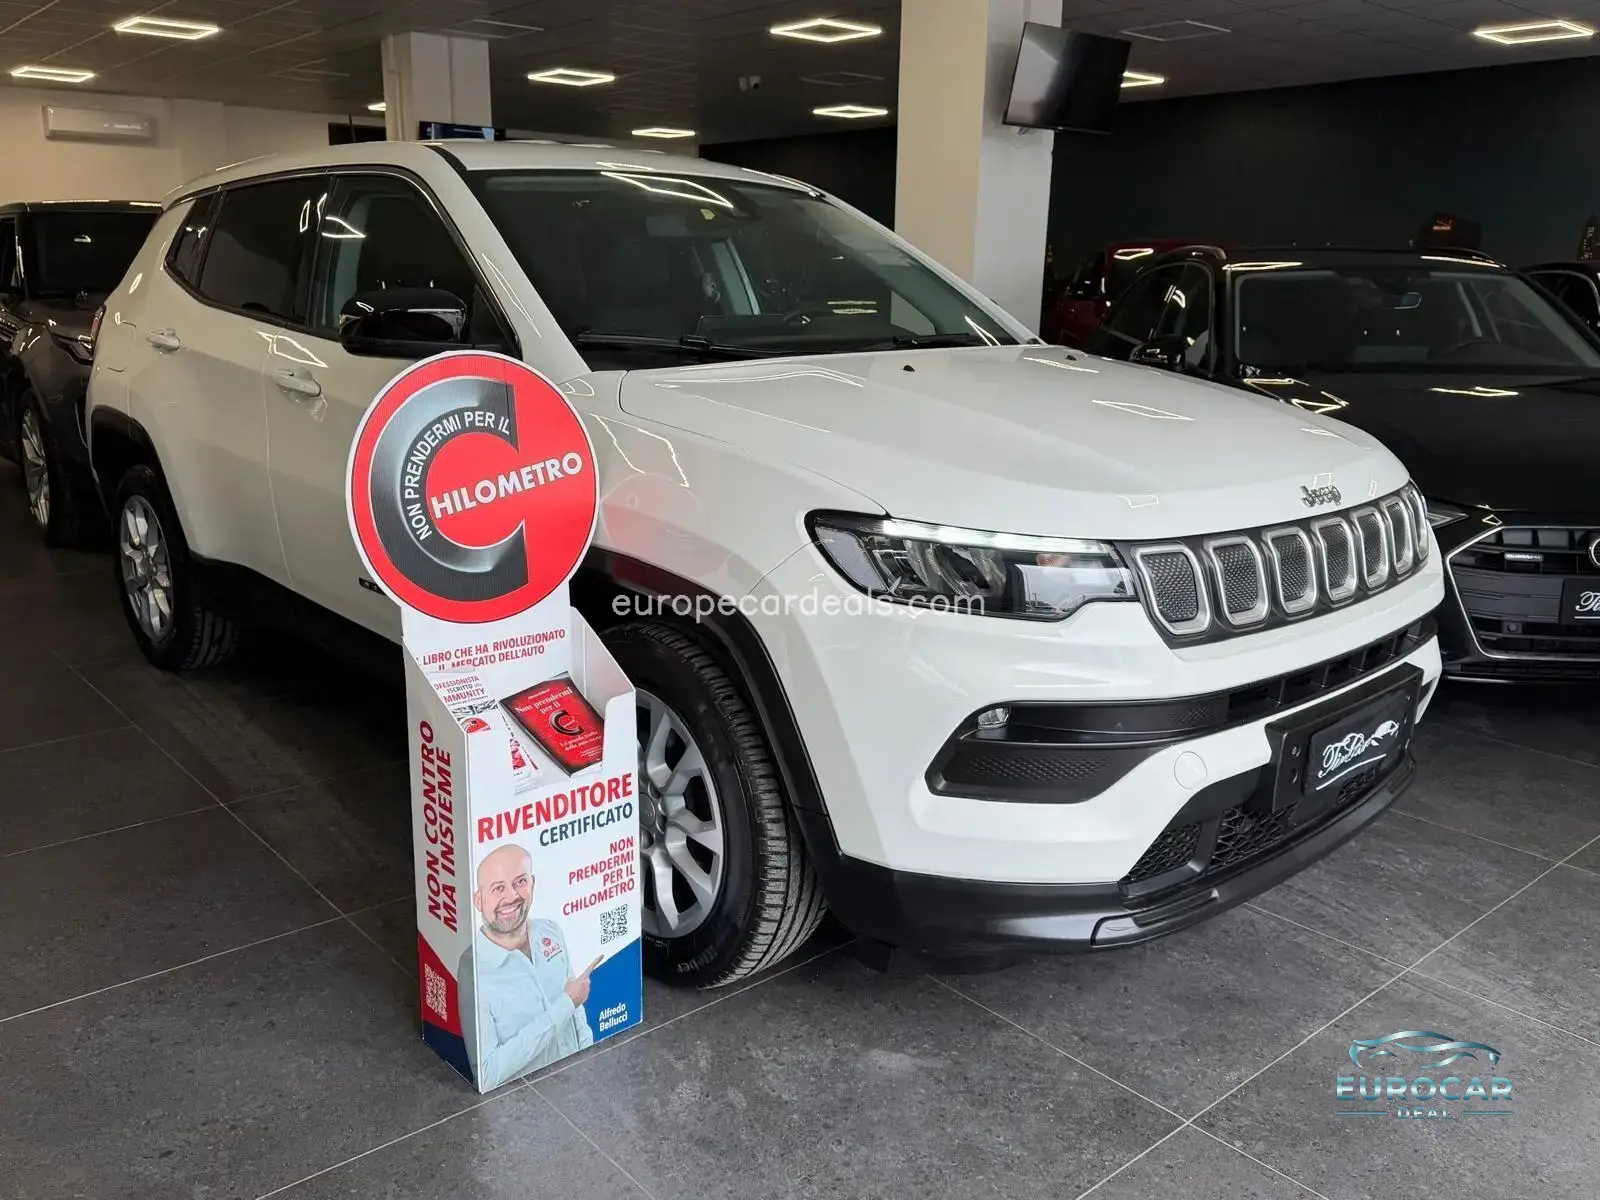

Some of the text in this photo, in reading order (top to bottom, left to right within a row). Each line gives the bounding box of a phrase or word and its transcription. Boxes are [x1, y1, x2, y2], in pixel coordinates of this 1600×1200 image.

[405, 411, 511, 541] NON PRENDERMI PER IL
[1300, 485, 1341, 507] Jeep
[423, 651, 451, 665] LIBRO
[454, 647, 473, 658] CHE
[475, 644, 489, 655] HA
[493, 629, 565, 651] RIVOLUZIONATO
[499, 645, 545, 662] DELL'AUTO
[420, 720, 441, 921] NON CONTRO
[477, 773, 633, 843] RIVENDITORE
[539, 802, 633, 847] CERTIFICATO
[436, 747, 457, 933] MA INSIEME
[609, 836, 634, 855] NON
[569, 852, 634, 885] PRENDERMI
[603, 866, 635, 887] PER IL
[562, 878, 635, 916] CHILOMETRO
[599, 1002, 626, 1022] Alfredo
[599, 1011, 628, 1032] Bellucci
